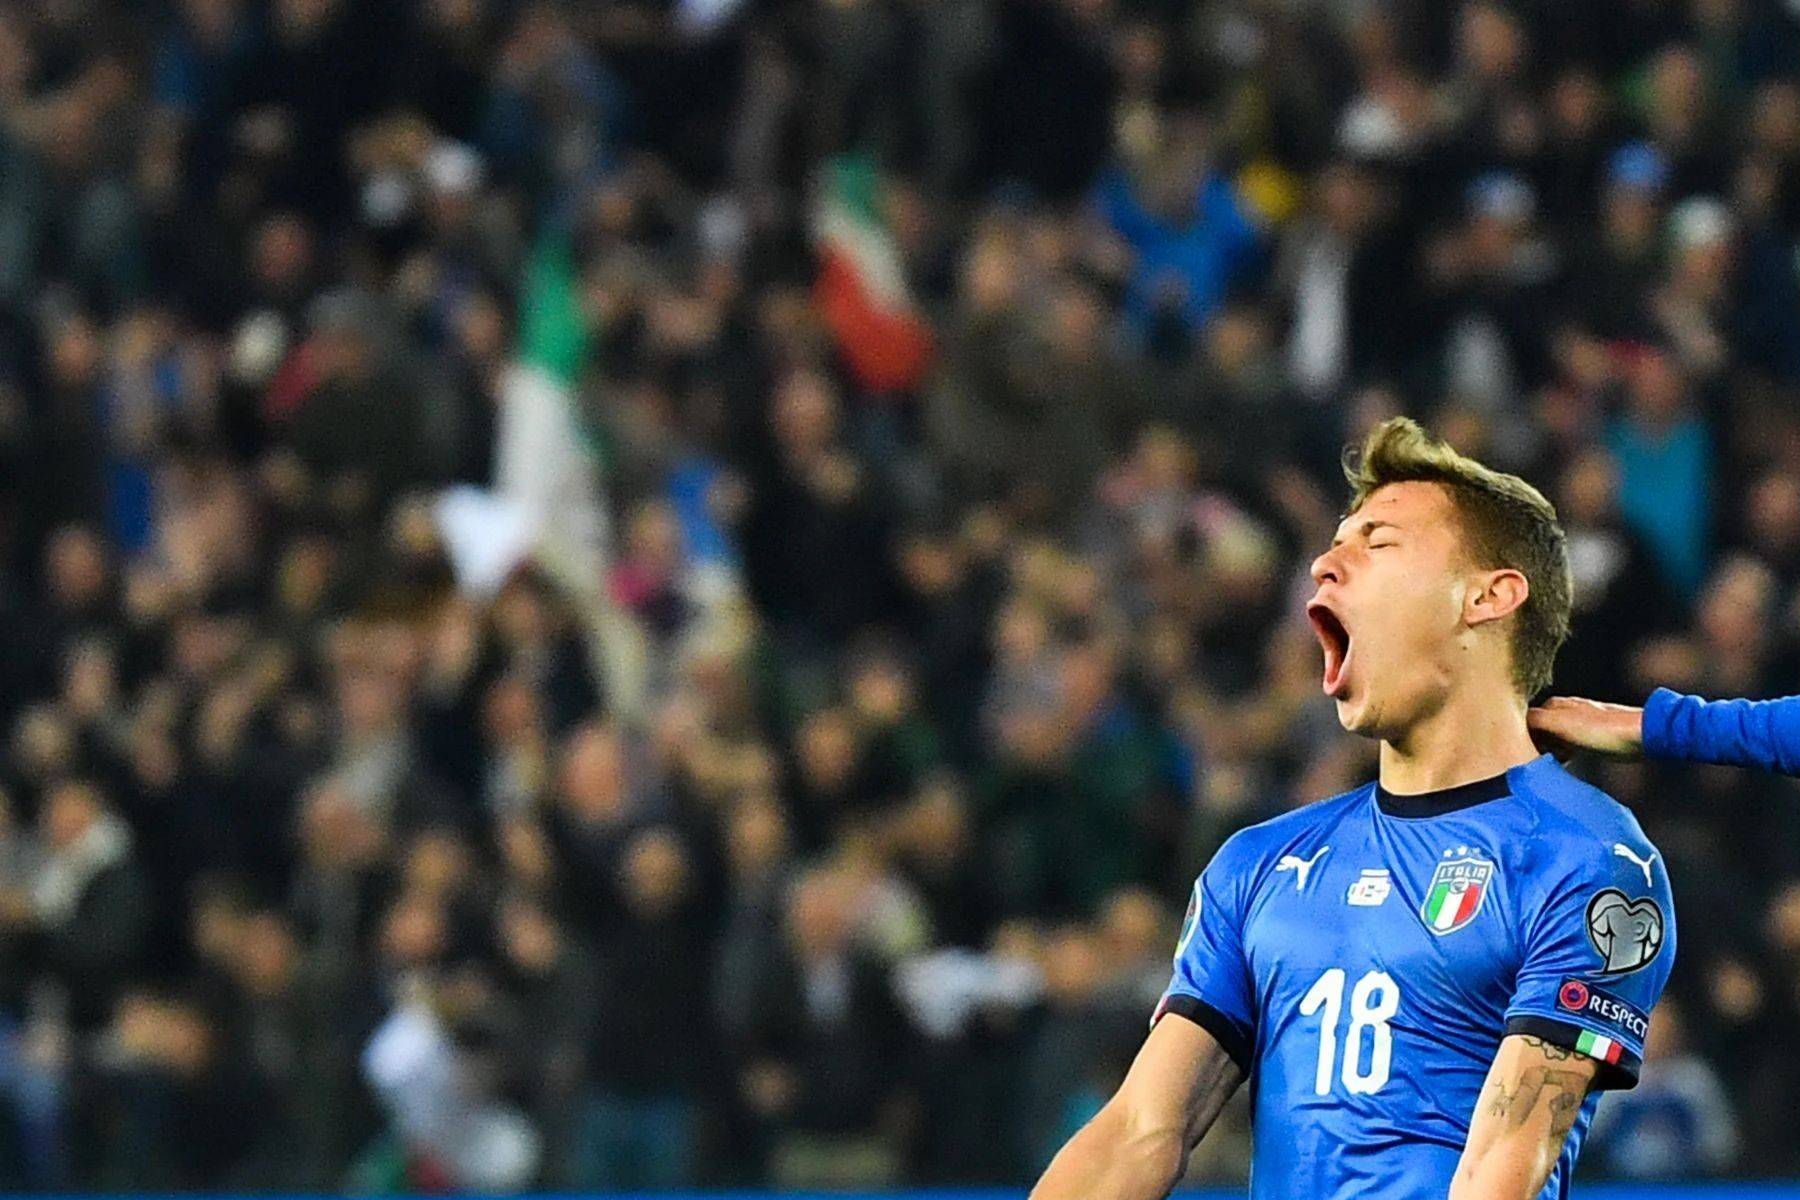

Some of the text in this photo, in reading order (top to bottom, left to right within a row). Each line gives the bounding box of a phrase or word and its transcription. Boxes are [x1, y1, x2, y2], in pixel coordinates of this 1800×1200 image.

[1439, 865, 1487, 880] ITALIA
[1299, 968, 1400, 1096] 18
[1588, 994, 1649, 1039] RESPECT
